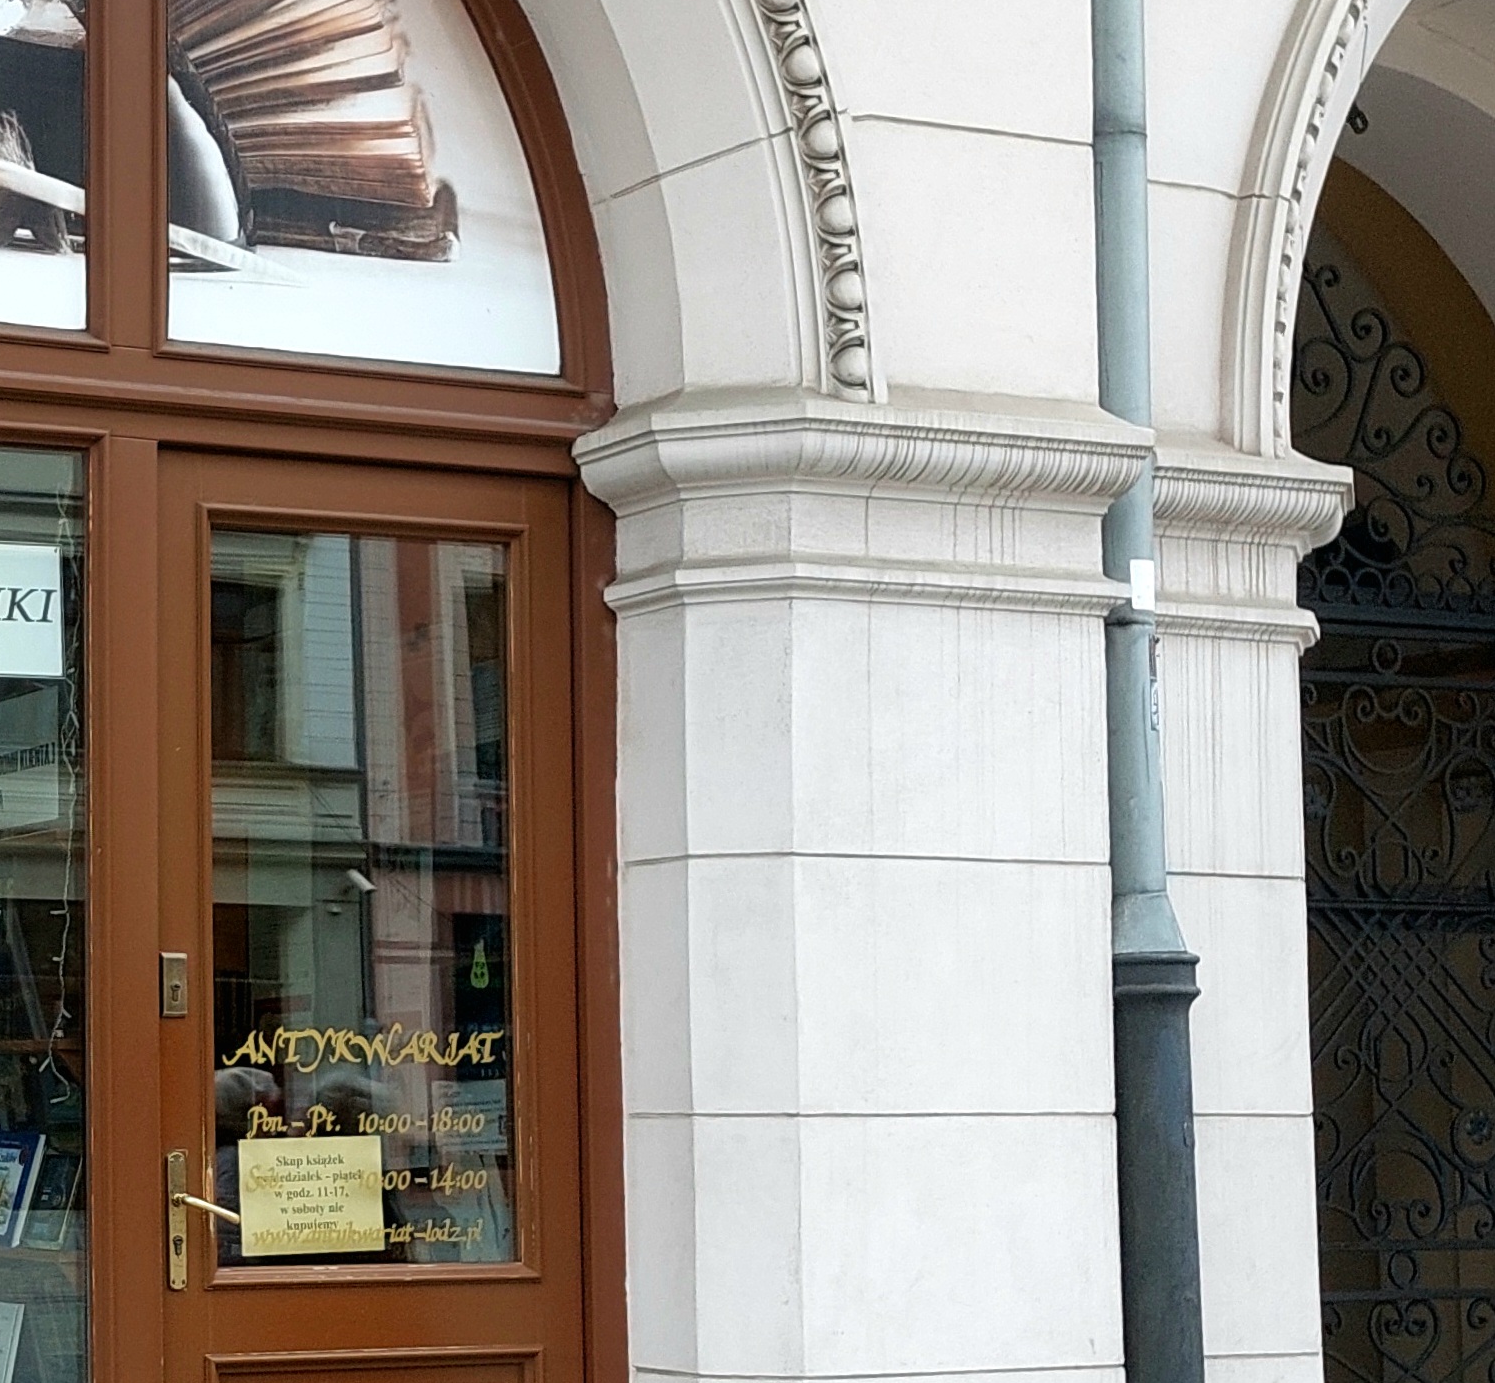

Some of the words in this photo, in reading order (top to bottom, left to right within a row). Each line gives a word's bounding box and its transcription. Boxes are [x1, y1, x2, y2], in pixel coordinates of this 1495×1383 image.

[222, 1022, 504, 1073] ANTYKWARIAT
[306, 1103, 341, 1139] Pt.
[358, 1111, 411, 1134] 10:00
[430, 1107, 485, 1134] 18:00
[276, 1155, 303, 1169] Skup
[430, 1162, 488, 1196] 14:00
